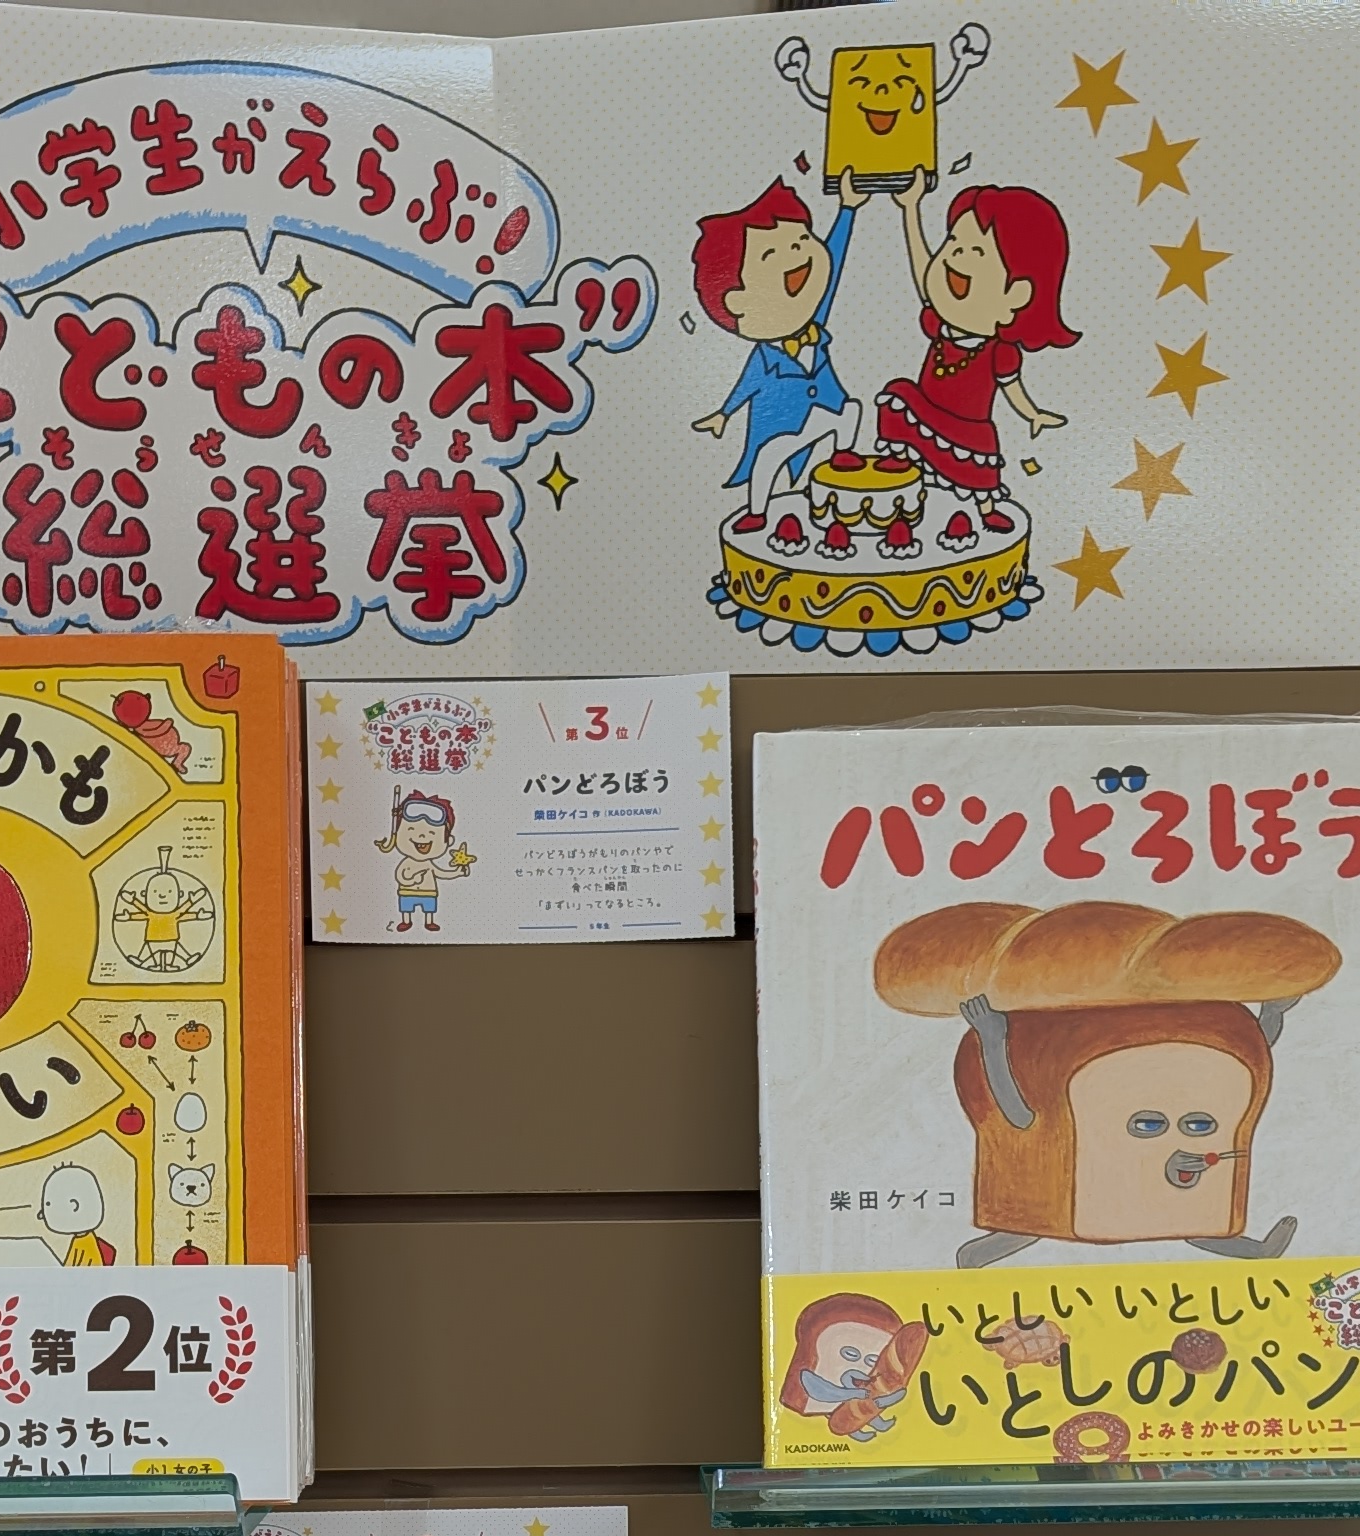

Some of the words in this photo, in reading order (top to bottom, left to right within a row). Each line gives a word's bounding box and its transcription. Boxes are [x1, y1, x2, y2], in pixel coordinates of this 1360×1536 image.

[1, 465, 507, 624] 総選挙
[565, 705, 629, 742] 第3位
[523, 768, 671, 795] パンどろぼう
[829, 1189, 956, 1212] 柴田ケイコ
[921, 1283, 1095, 1345] いとしい
[1115, 1276, 1290, 1328] いとしい
[29, 1296, 213, 1392] 第2位
[784, 1443, 852, 1454] KADOKAWA
